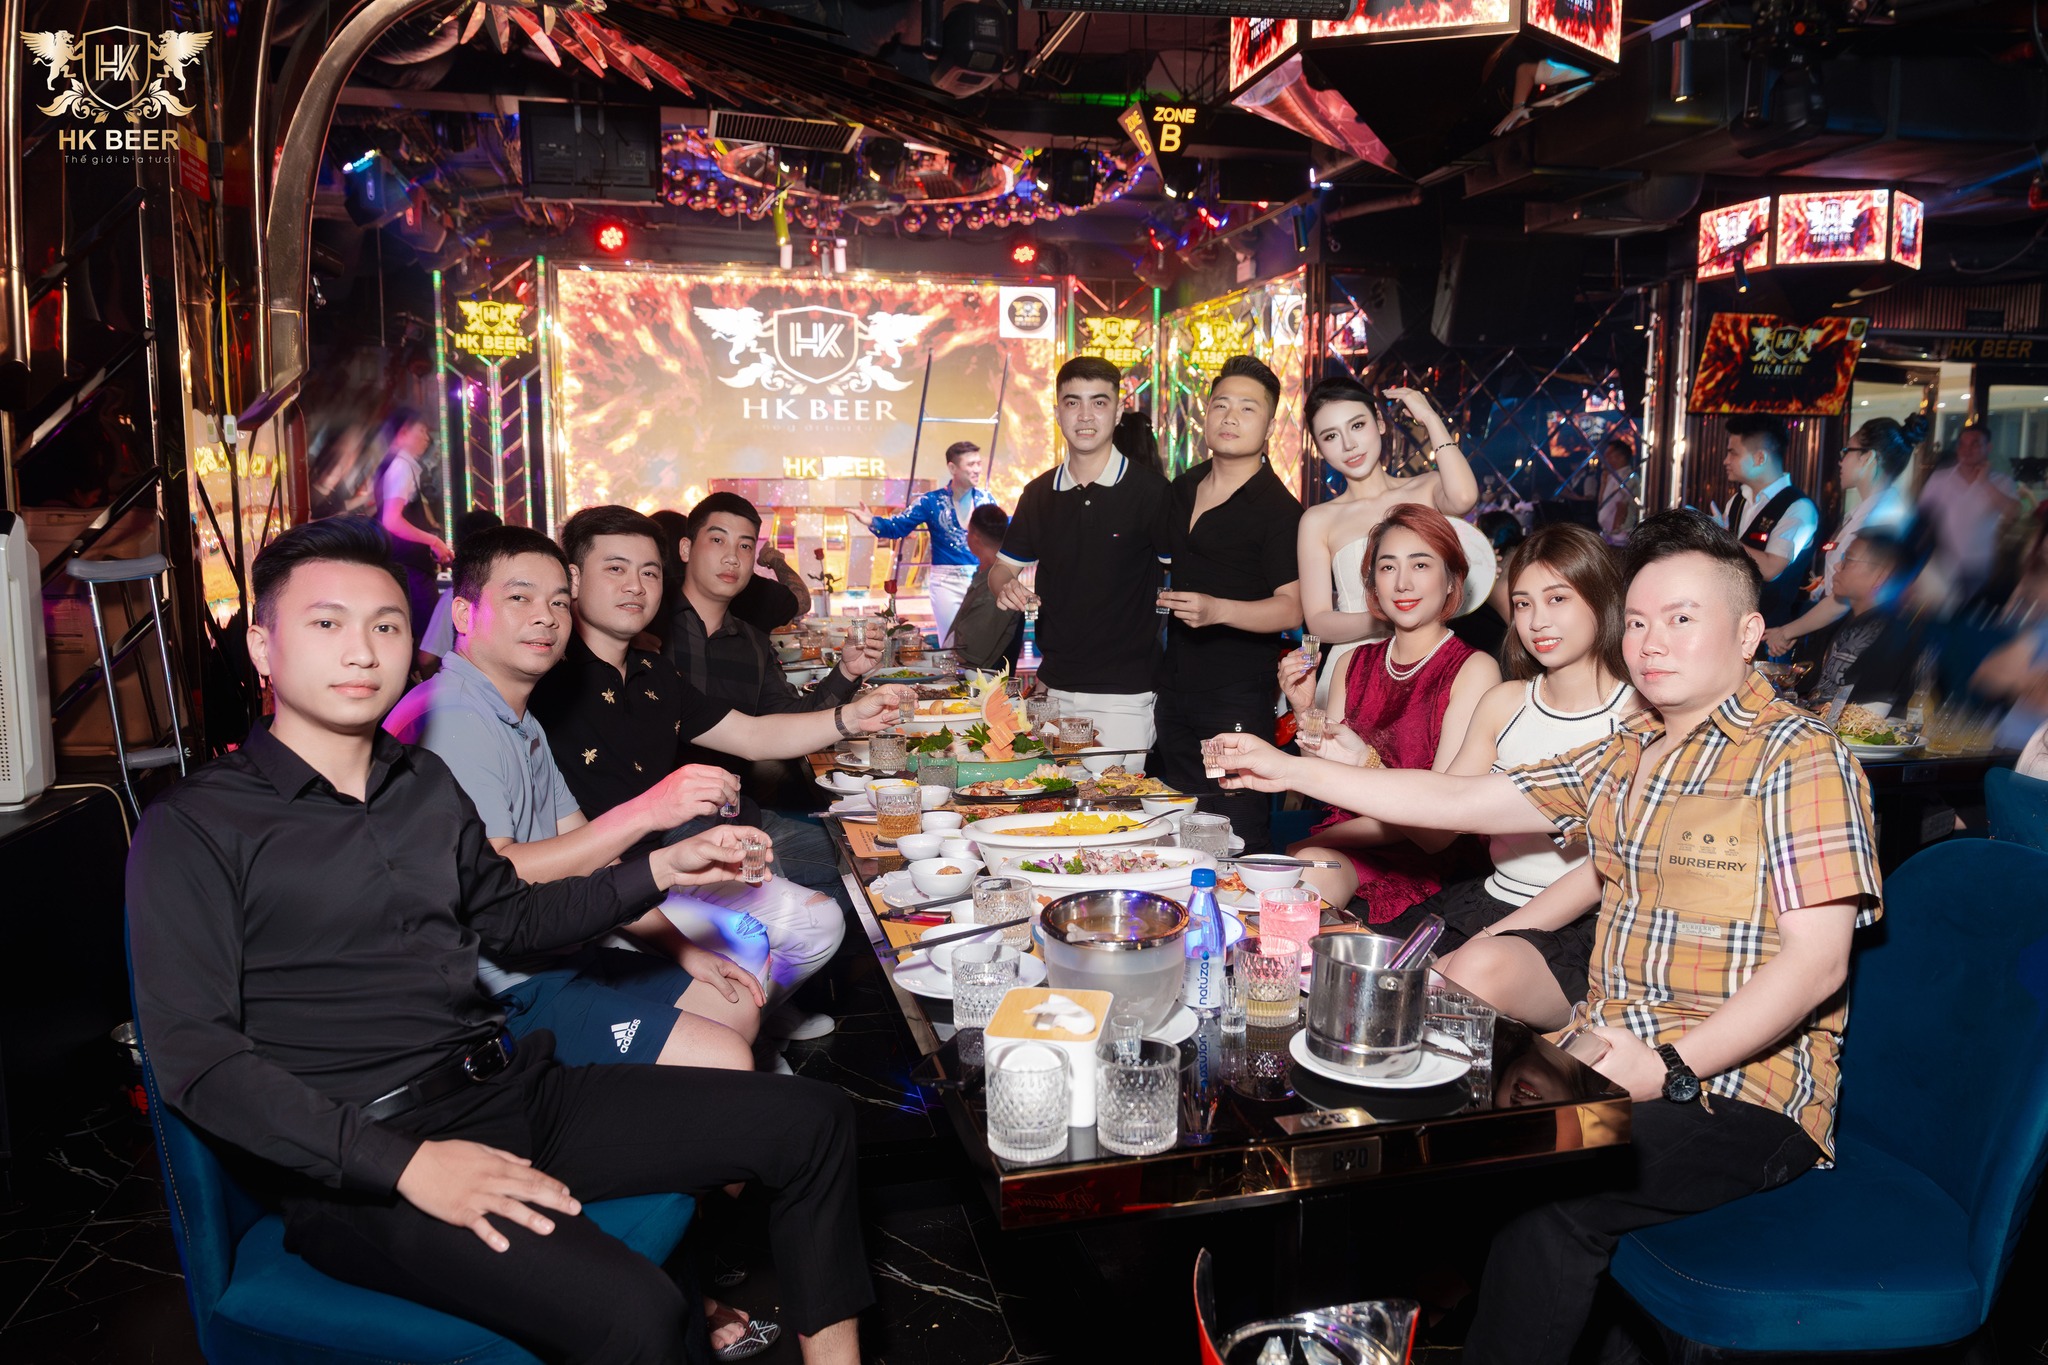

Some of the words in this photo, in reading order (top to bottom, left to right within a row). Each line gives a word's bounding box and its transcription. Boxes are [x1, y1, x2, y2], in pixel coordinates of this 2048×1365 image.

[1153, 106, 1197, 124] ZONE
[1134, 129, 1152, 156] B
[1159, 123, 1182, 152] B
[455, 333, 480, 349] HK
[482, 335, 529, 352] BEER
[789, 322, 845, 358] HK
[1948, 338, 1977, 358] HK
[1980, 339, 2033, 359] BEER
[1104, 348, 1143, 362] BEER
[1753, 364, 1771, 375] HK
[743, 398, 799, 420] HK
[809, 398, 897, 421] BEER
[785, 456, 820, 477] HK
[1669, 855, 1747, 872] BURBERRY
[1197, 962, 1209, 1006] natúza
[619, 1018, 641, 1054] adidas
[1333, 1147, 1369, 1171] B20
